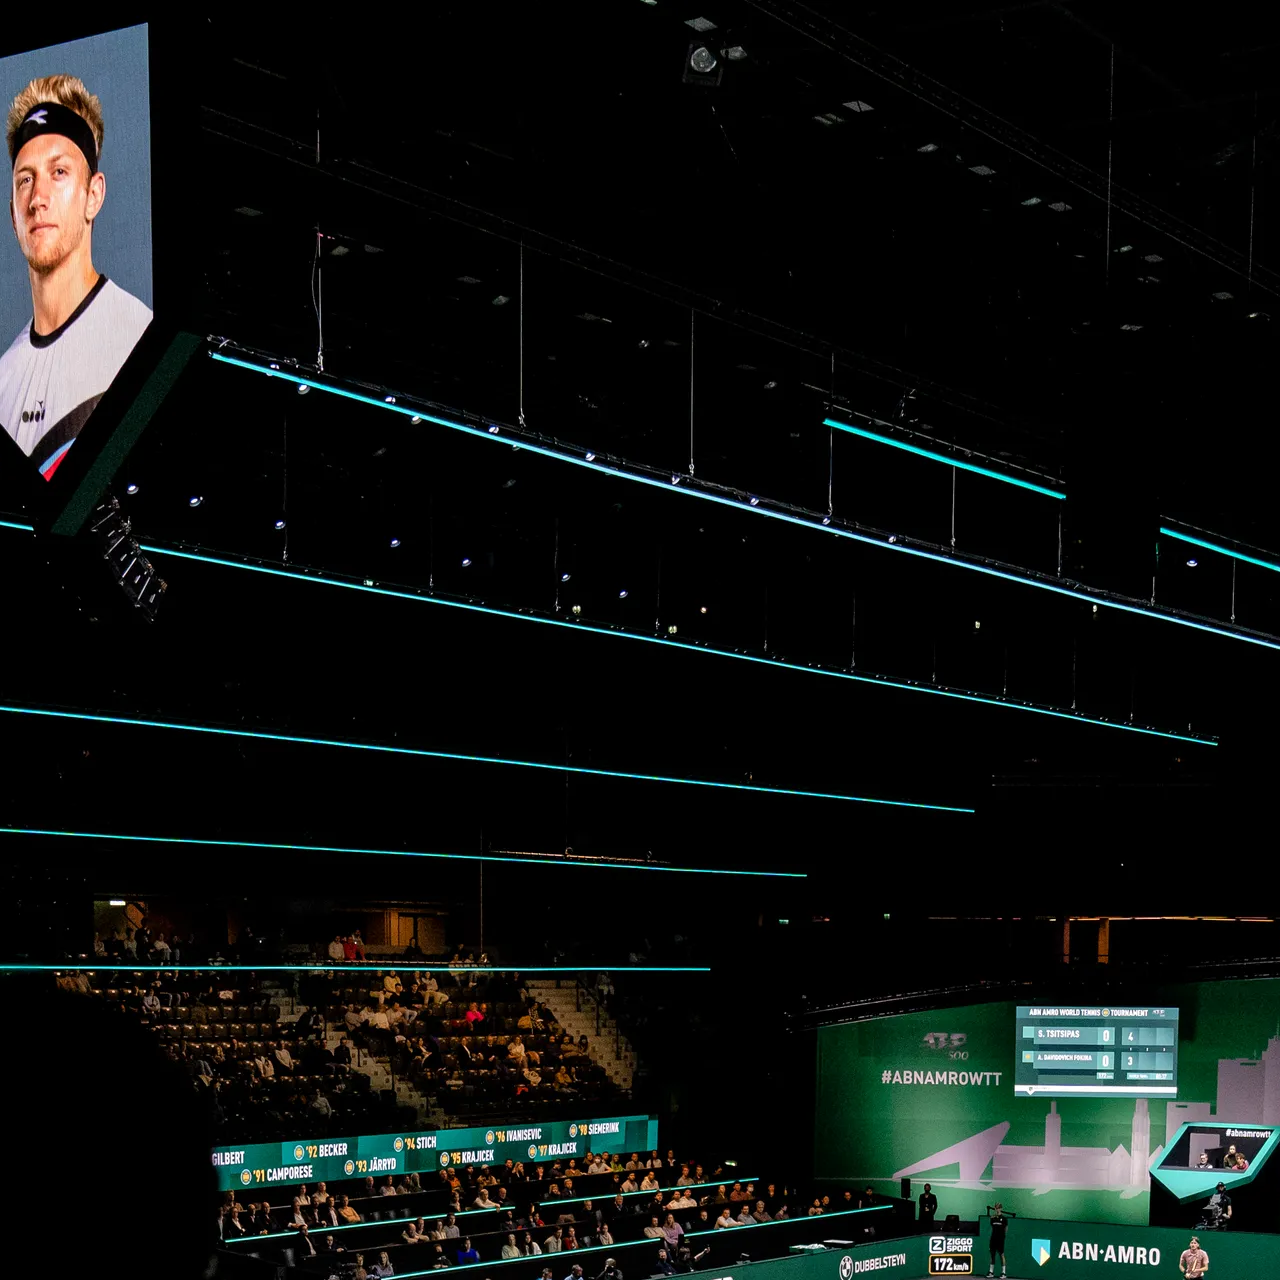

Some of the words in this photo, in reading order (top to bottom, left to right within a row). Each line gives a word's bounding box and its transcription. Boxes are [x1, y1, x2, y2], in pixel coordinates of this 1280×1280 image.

[1060, 1009, 1081, 1017] WORLD
[1081, 1009, 1101, 1017] TENNIS
[921, 1032, 968, 1049] ATP
[1038, 1030, 1045, 1038] S.
[1046, 1030, 1080, 1038] TSITSIPAS
[1103, 1030, 1110, 1042] 0
[1128, 1032, 1134, 1041] 4
[948, 1051, 969, 1061] 500
[1102, 1055, 1109, 1068] 0
[1128, 1056, 1133, 1066] 3
[881, 1070, 1002, 1086] #ABNAMROWTT
[506, 1127, 542, 1143] IVANISEVIC
[1225, 1128, 1271, 1138] #abnamrowtt
[416, 1135, 437, 1149] STICH
[548, 1142, 577, 1156] KRAJICEK
[306, 1144, 318, 1158] '92
[319, 1142, 348, 1157] BECKER
[461, 1148, 494, 1163] KRAJICEK
[211, 1150, 245, 1166] GILBERT
[368, 1156, 396, 1172] JÄRRYD
[253, 1168, 265, 1183] '91
[267, 1164, 313, 1182] CAMPORESE
[854, 1253, 906, 1274] DUBBELSTEYN
[933, 1257, 953, 1271] 172
[953, 1263, 969, 1272] km/h
